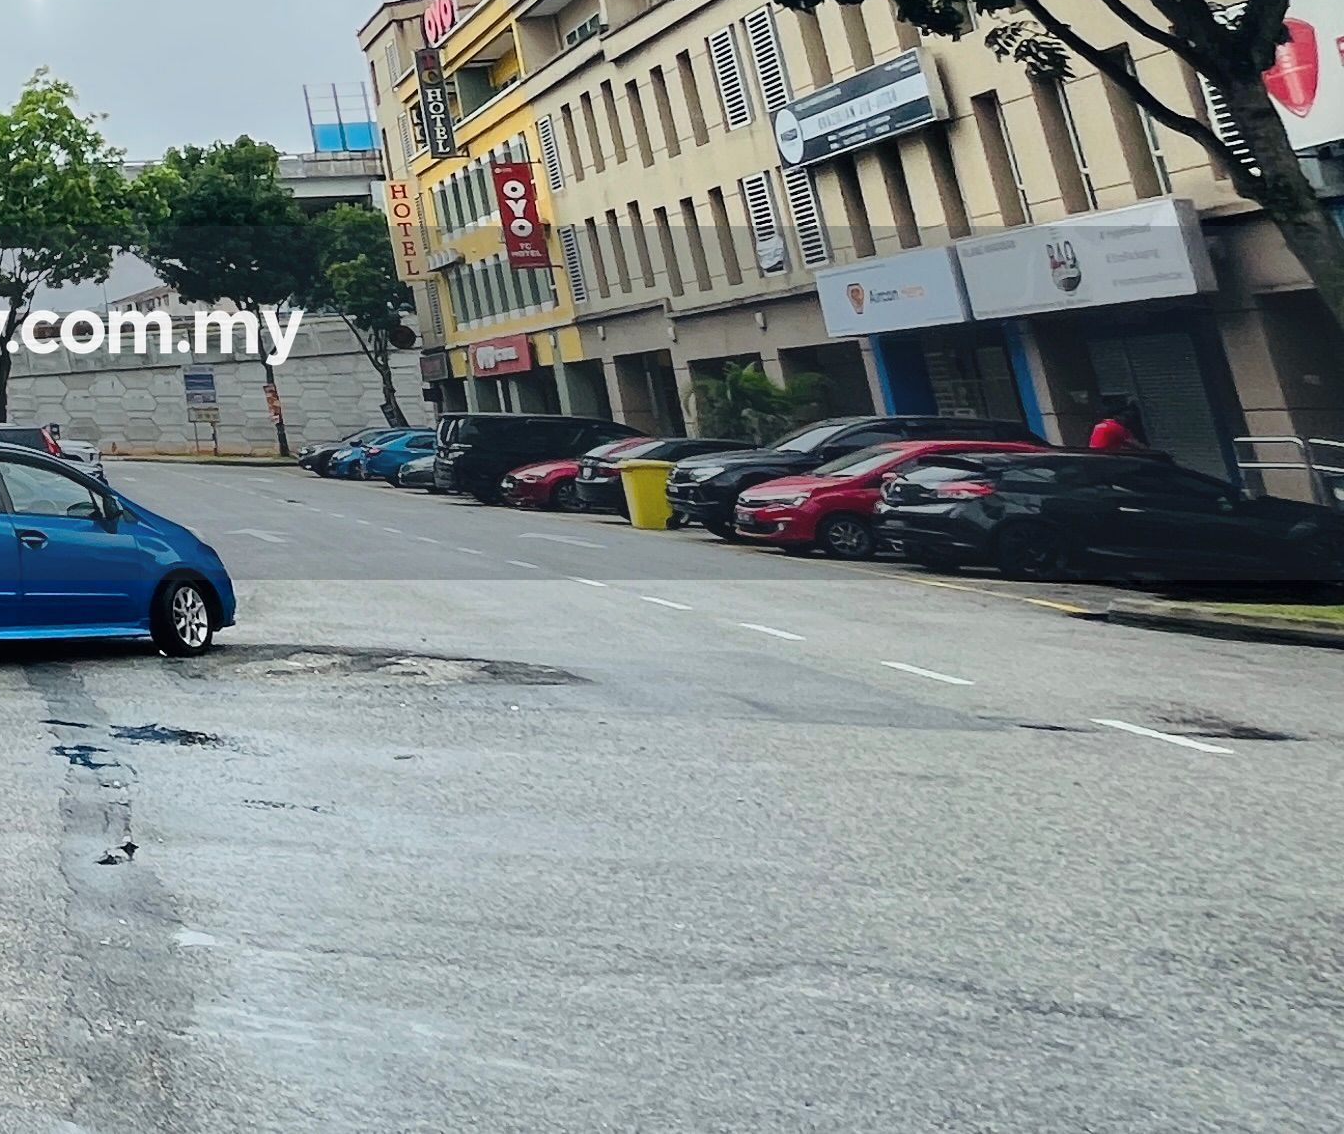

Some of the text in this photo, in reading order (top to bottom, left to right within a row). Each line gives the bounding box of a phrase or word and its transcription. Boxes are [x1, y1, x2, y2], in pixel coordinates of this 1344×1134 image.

[424, 88, 451, 154] HOTEL
[389, 183, 420, 276] HOTEL
[502, 179, 534, 238] OYO
